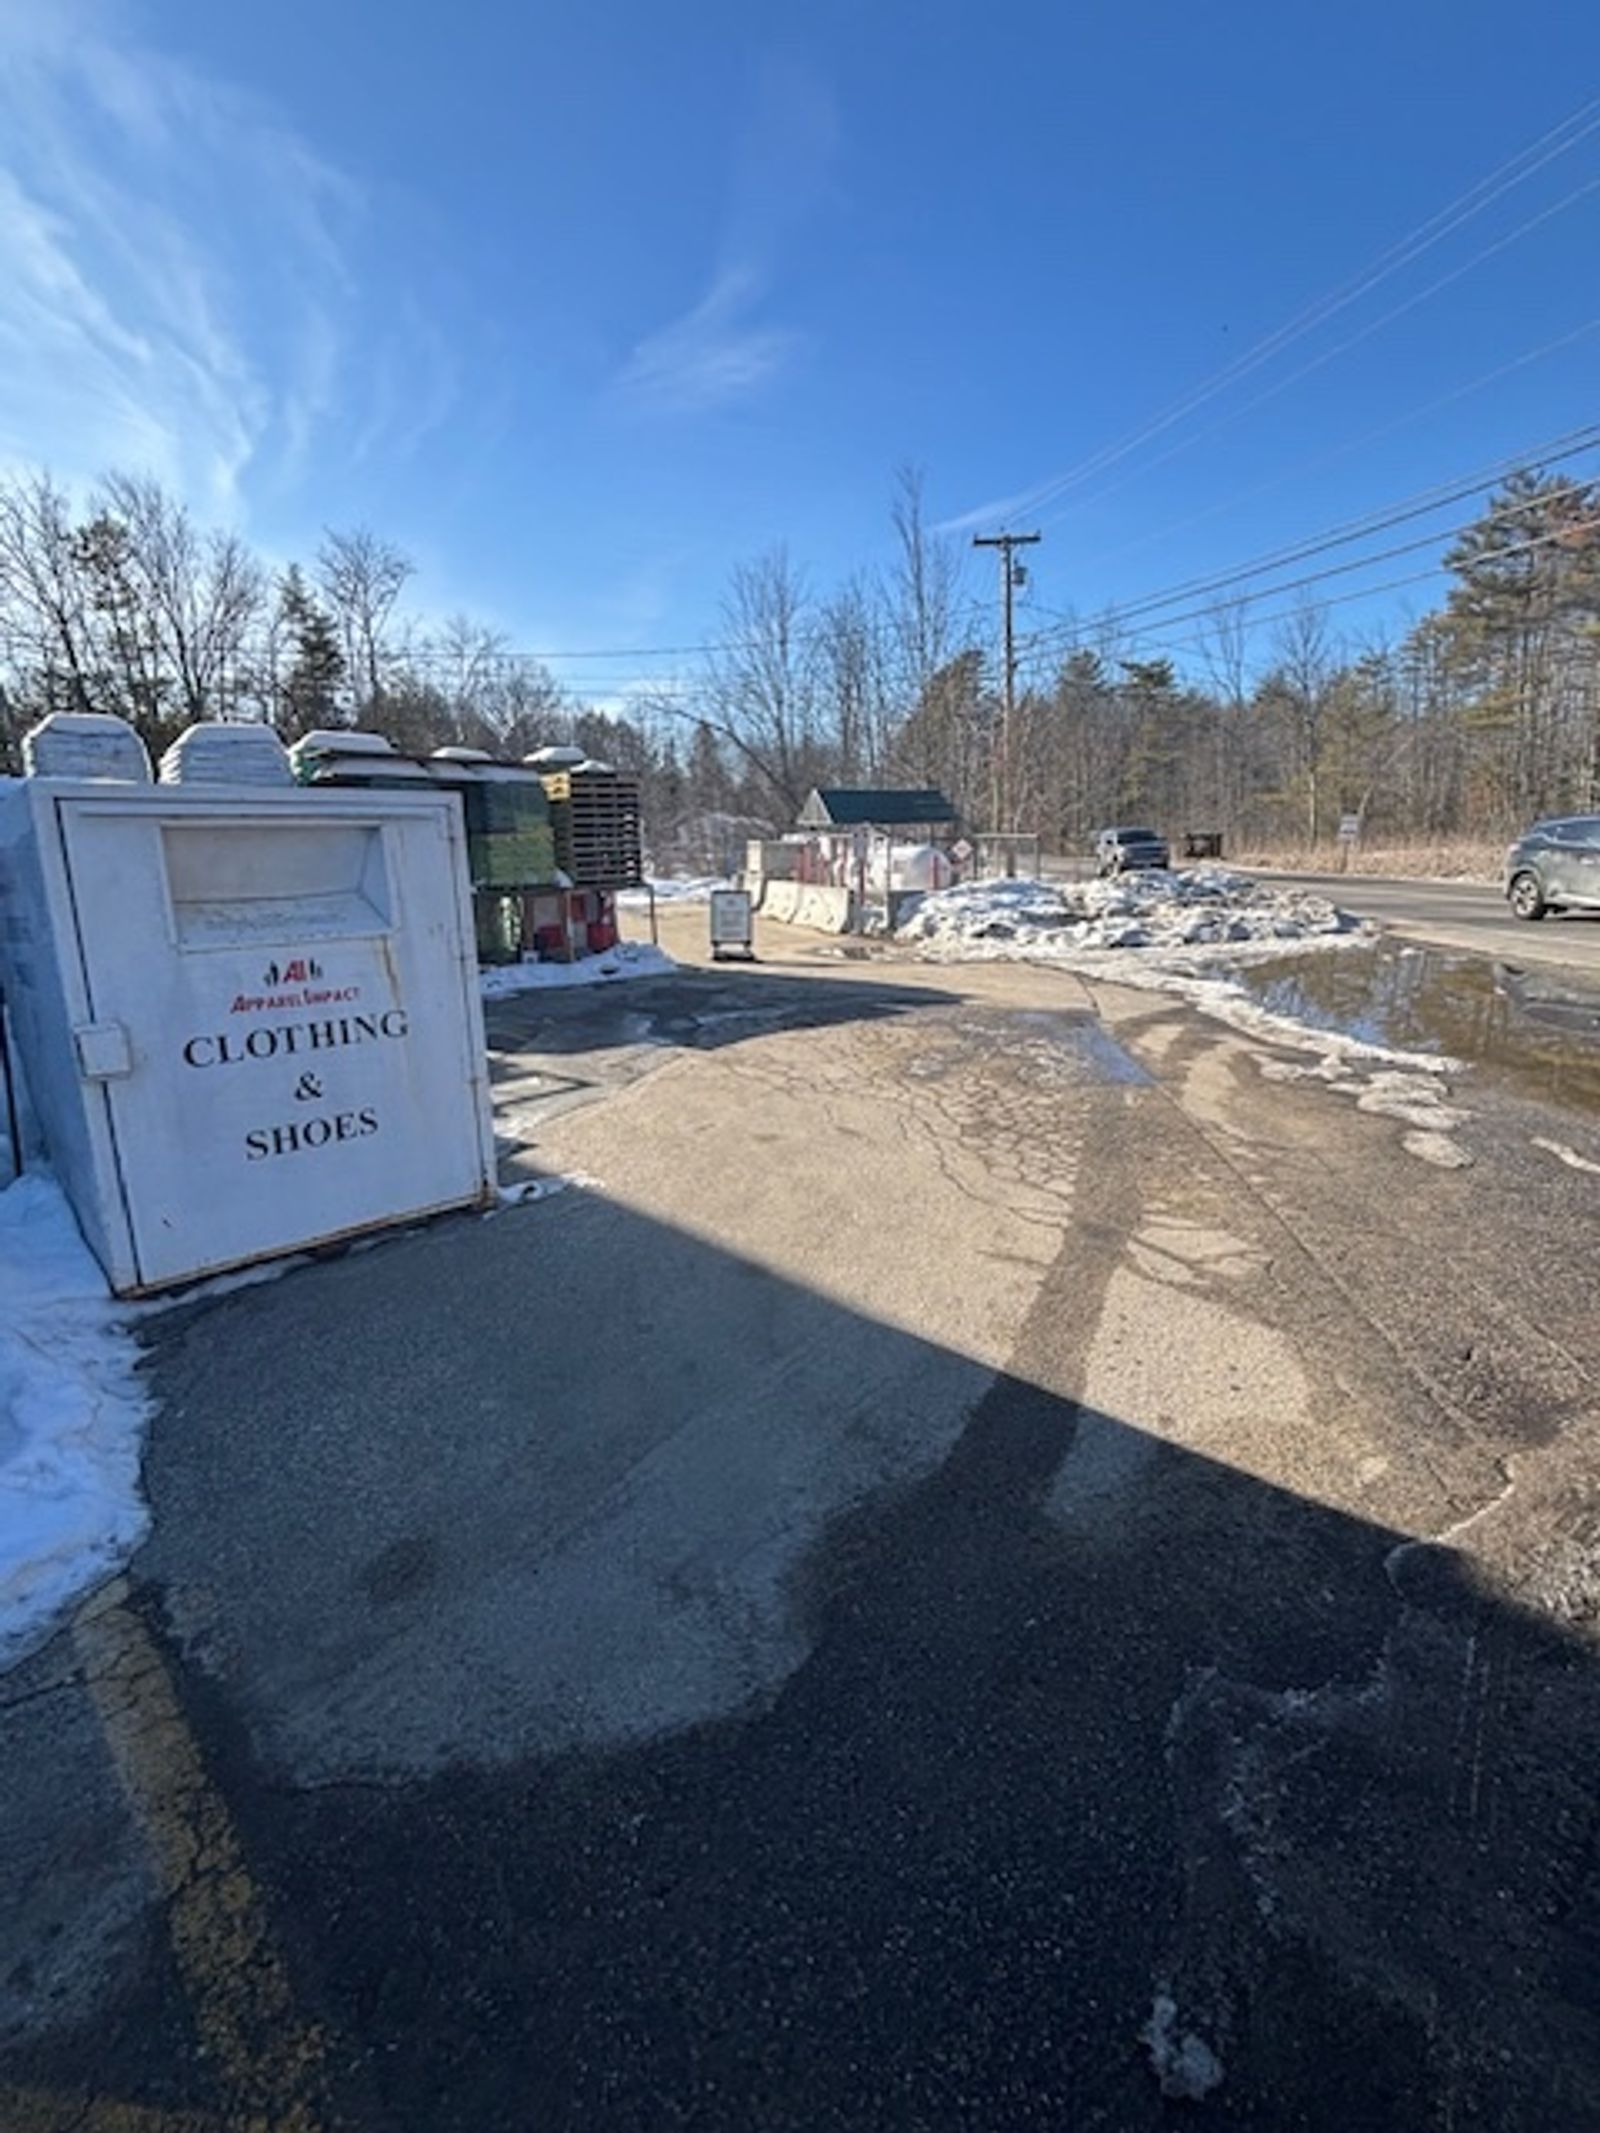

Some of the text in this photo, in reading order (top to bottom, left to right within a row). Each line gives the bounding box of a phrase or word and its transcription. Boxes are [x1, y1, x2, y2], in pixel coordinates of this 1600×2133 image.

[183, 1010, 409, 1068] CLOTHING
[294, 1070, 323, 1102] &
[245, 1107, 379, 1162] SHOES
